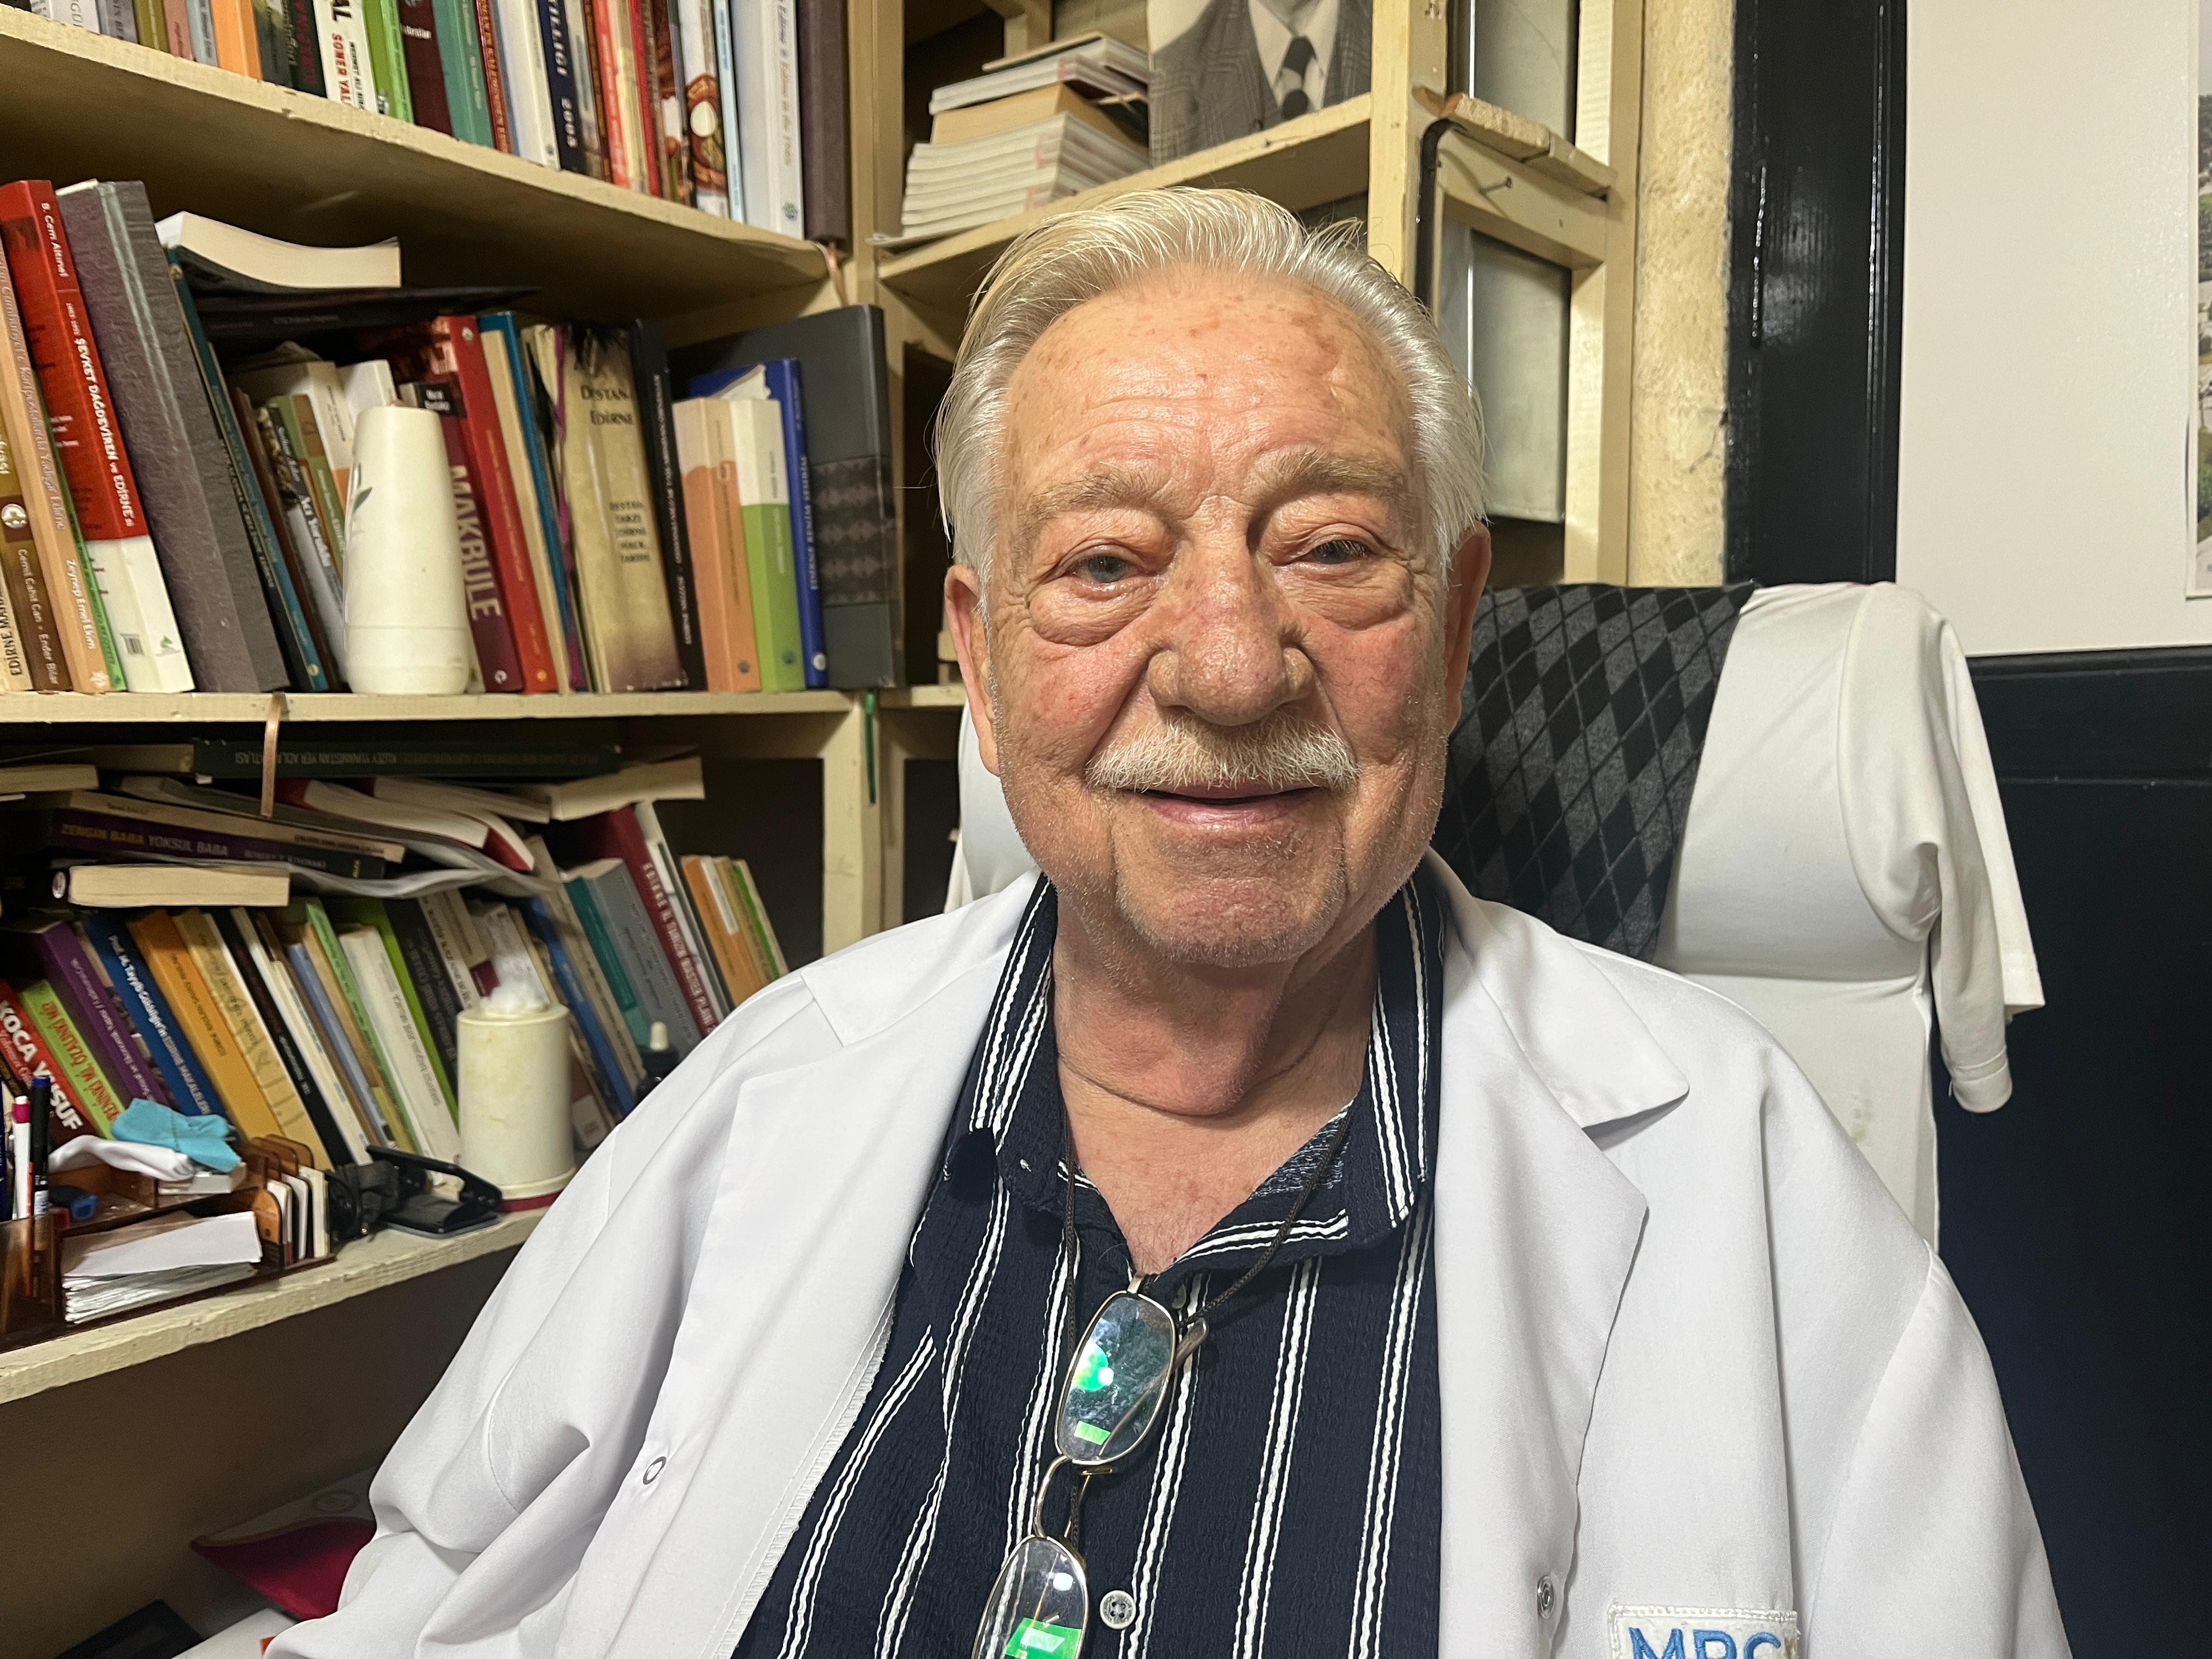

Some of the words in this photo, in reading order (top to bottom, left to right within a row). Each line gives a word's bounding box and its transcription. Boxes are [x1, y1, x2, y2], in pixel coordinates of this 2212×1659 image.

[332, 33, 347, 76] SONER
[560, 98, 578, 148] 2005
[42, 203, 50, 214] B.
[44, 216, 59, 242] Cem
[75, 337, 97, 384] ŞEVKET
[88, 384, 119, 460] DAĞDEVİREN
[450, 465, 501, 622] MAKBULE
[65, 557, 82, 596] Zeynep
[2, 630, 21, 676] EDİRNE
[235, 753, 262, 765] TLASI
[147, 835, 193, 852] YOKSUL
[195, 841, 229, 856] BABA
[0, 1000, 38, 1063] KOCA
[33, 1060, 83, 1130] YSUF
